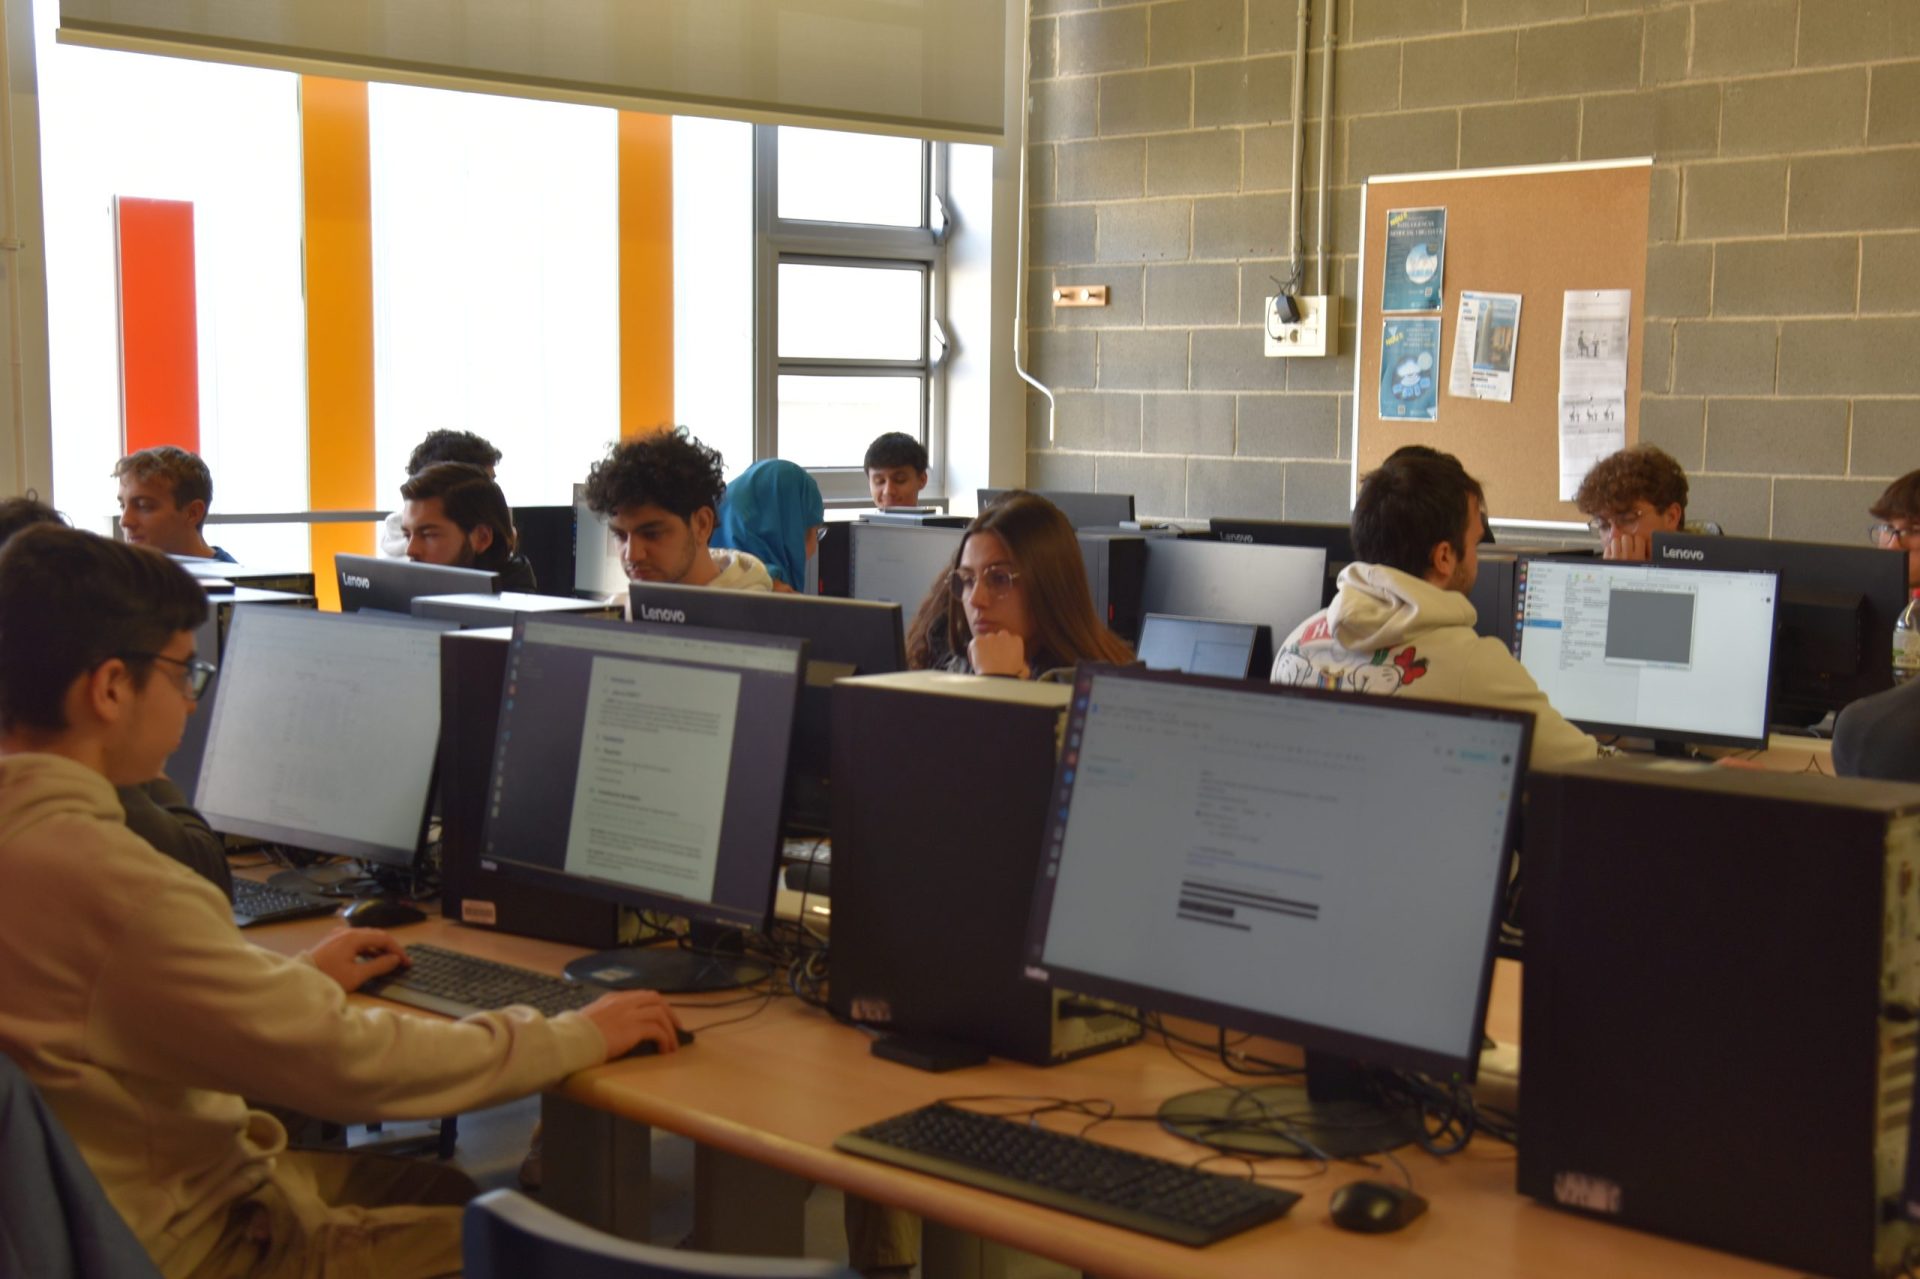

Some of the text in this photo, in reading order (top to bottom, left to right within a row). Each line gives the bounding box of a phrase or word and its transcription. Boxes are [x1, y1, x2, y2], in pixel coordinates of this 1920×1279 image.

[1663, 545, 1704, 561] Lenovo
[342, 571, 370, 589] Lenovo
[641, 603, 686, 623] Lenovo
